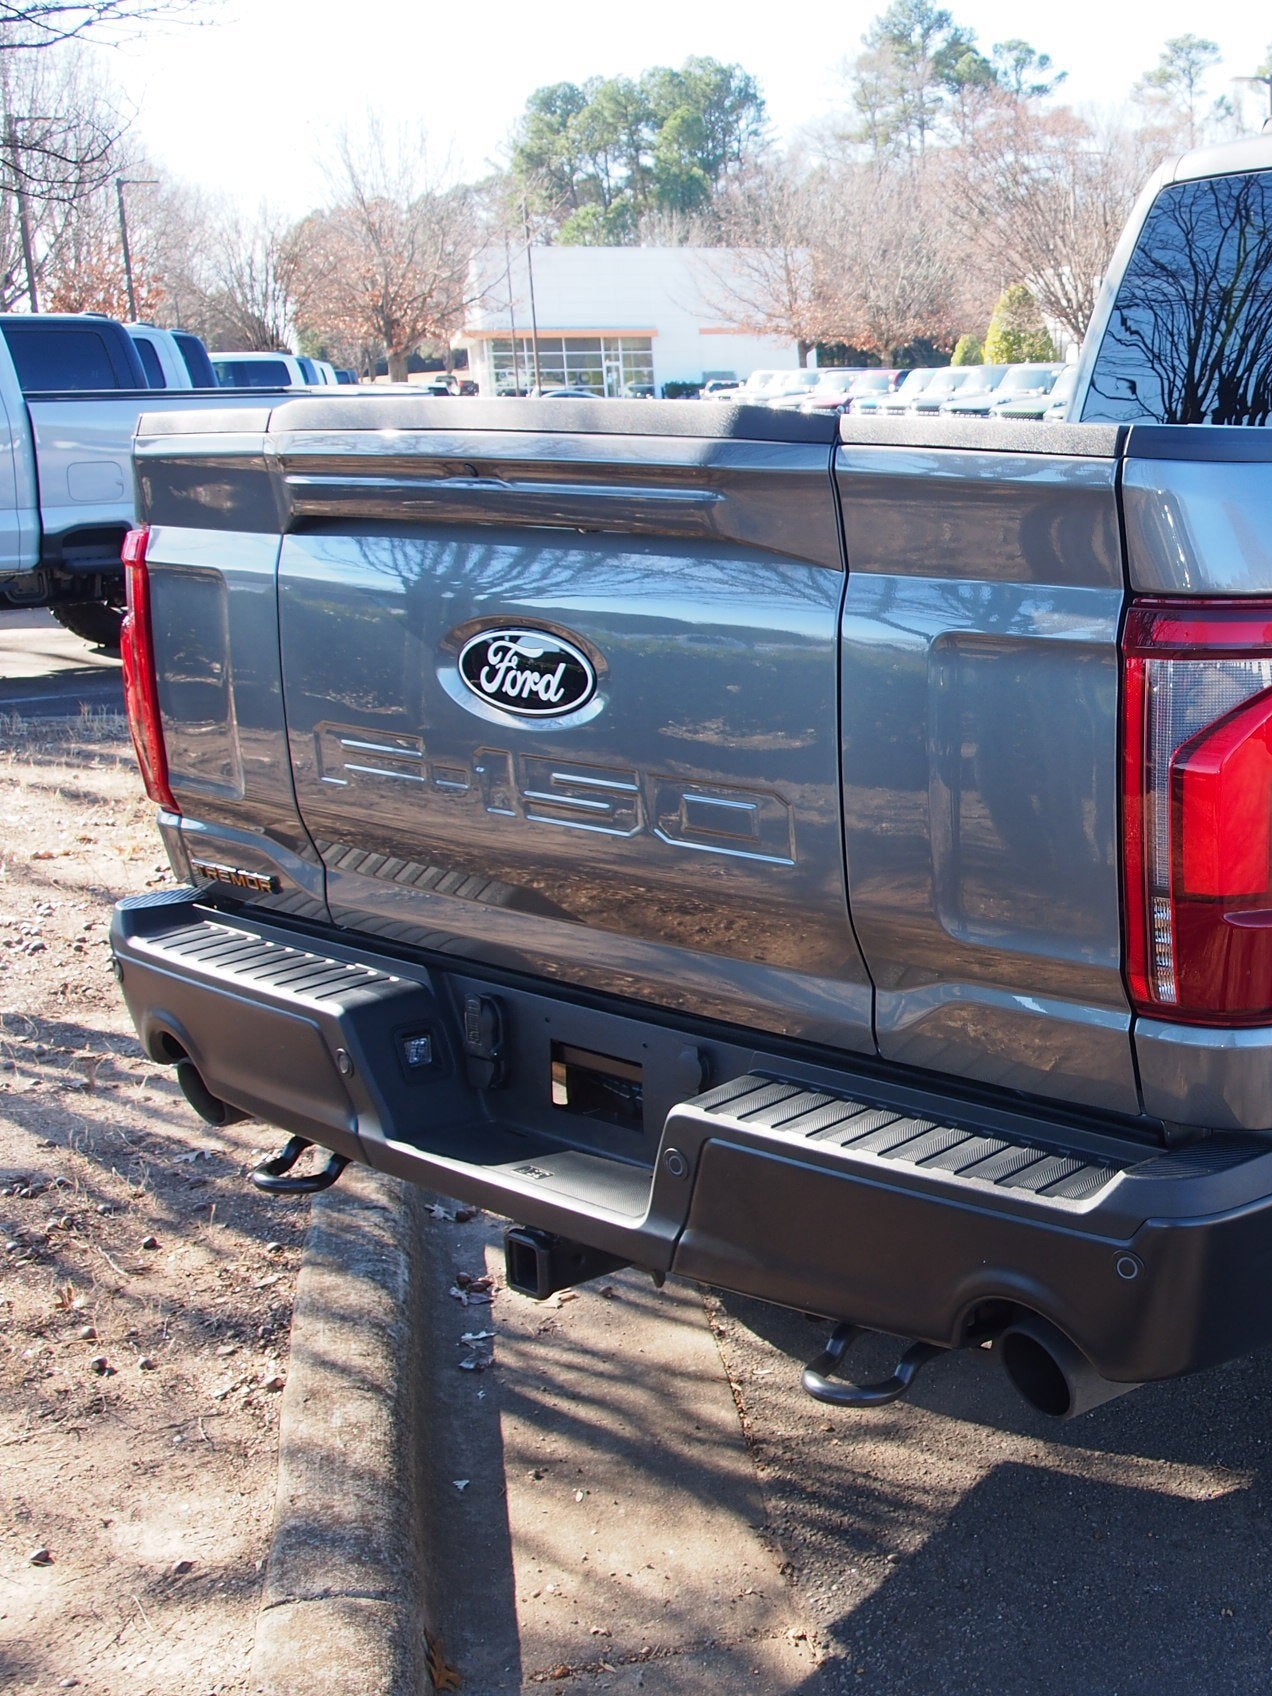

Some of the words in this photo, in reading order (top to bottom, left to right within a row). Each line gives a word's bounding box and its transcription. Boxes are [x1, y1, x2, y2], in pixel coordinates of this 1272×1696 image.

[480, 640, 566, 703] Ford
[314, 719, 798, 867] F-150
[193, 862, 273, 894] TREMOR
